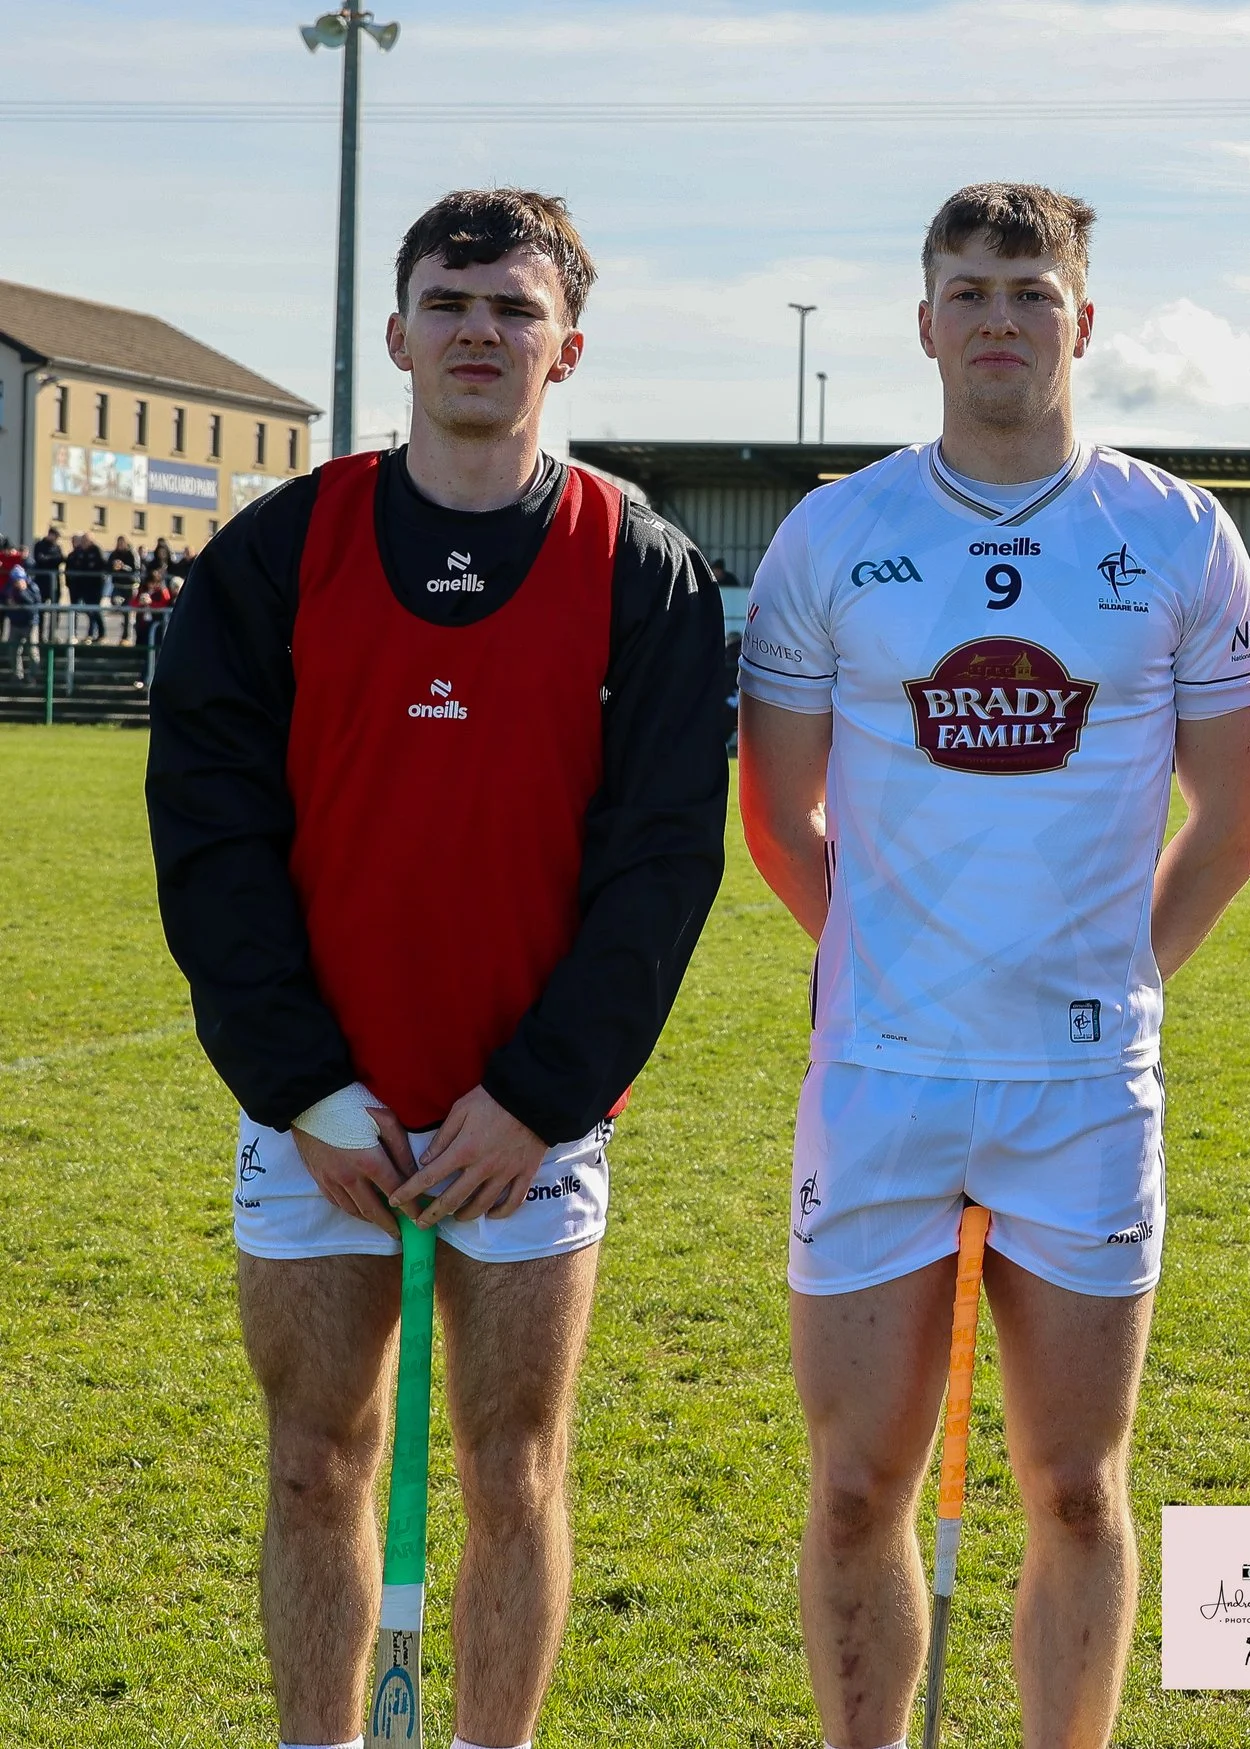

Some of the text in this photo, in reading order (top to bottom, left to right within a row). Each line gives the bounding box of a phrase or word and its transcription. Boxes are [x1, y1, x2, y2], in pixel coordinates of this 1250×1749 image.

[149, 470, 218, 498] MANGUARD PARK
[985, 563, 1023, 610] 9
[1098, 603, 1149, 614] KILDARE GAA
[751, 634, 803, 663] HOMES
[922, 687, 1082, 720] BRADY
[937, 722, 1066, 750] FAMILY
